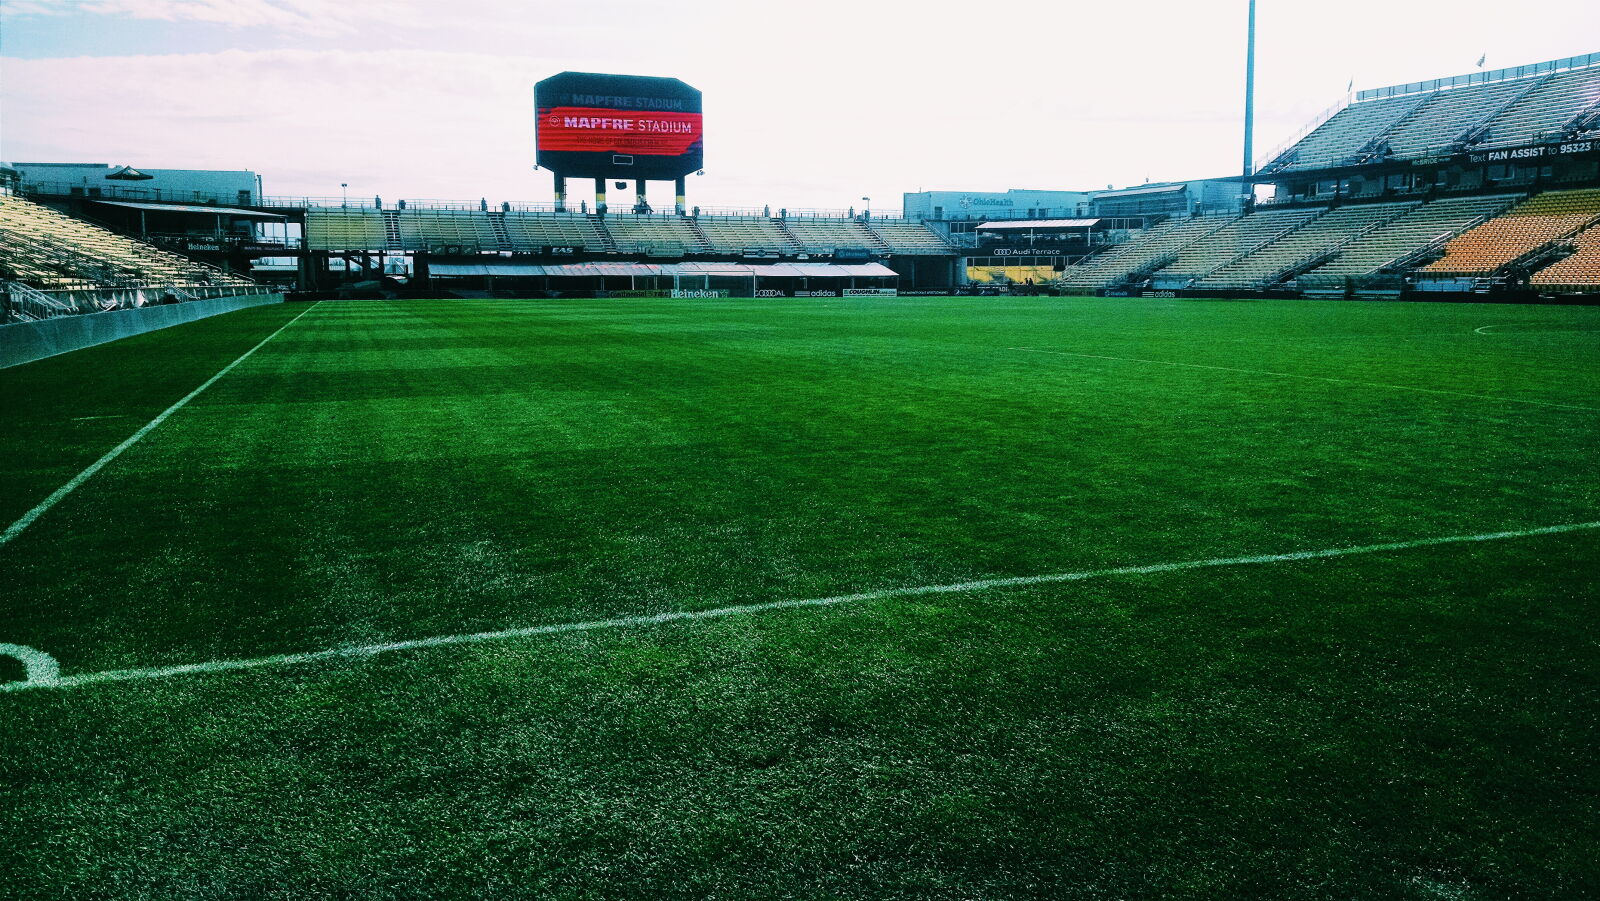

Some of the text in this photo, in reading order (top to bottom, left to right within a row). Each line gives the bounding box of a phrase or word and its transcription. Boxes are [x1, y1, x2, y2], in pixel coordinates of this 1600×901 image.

[572, 94, 682, 110] MAPFRE STADIUM
[564, 117, 692, 133] MAPFRE STADIUM
[1469, 154, 1486, 163] Text
[1488, 151, 1508, 160] FAN
[1510, 147, 1545, 158] ASSIST
[1548, 147, 1558, 155] to
[1560, 142, 1591, 153] 95323
[187, 243, 220, 251] Heineken
[671, 289, 719, 298] Heineken
[1154, 290, 1176, 298] adidas
